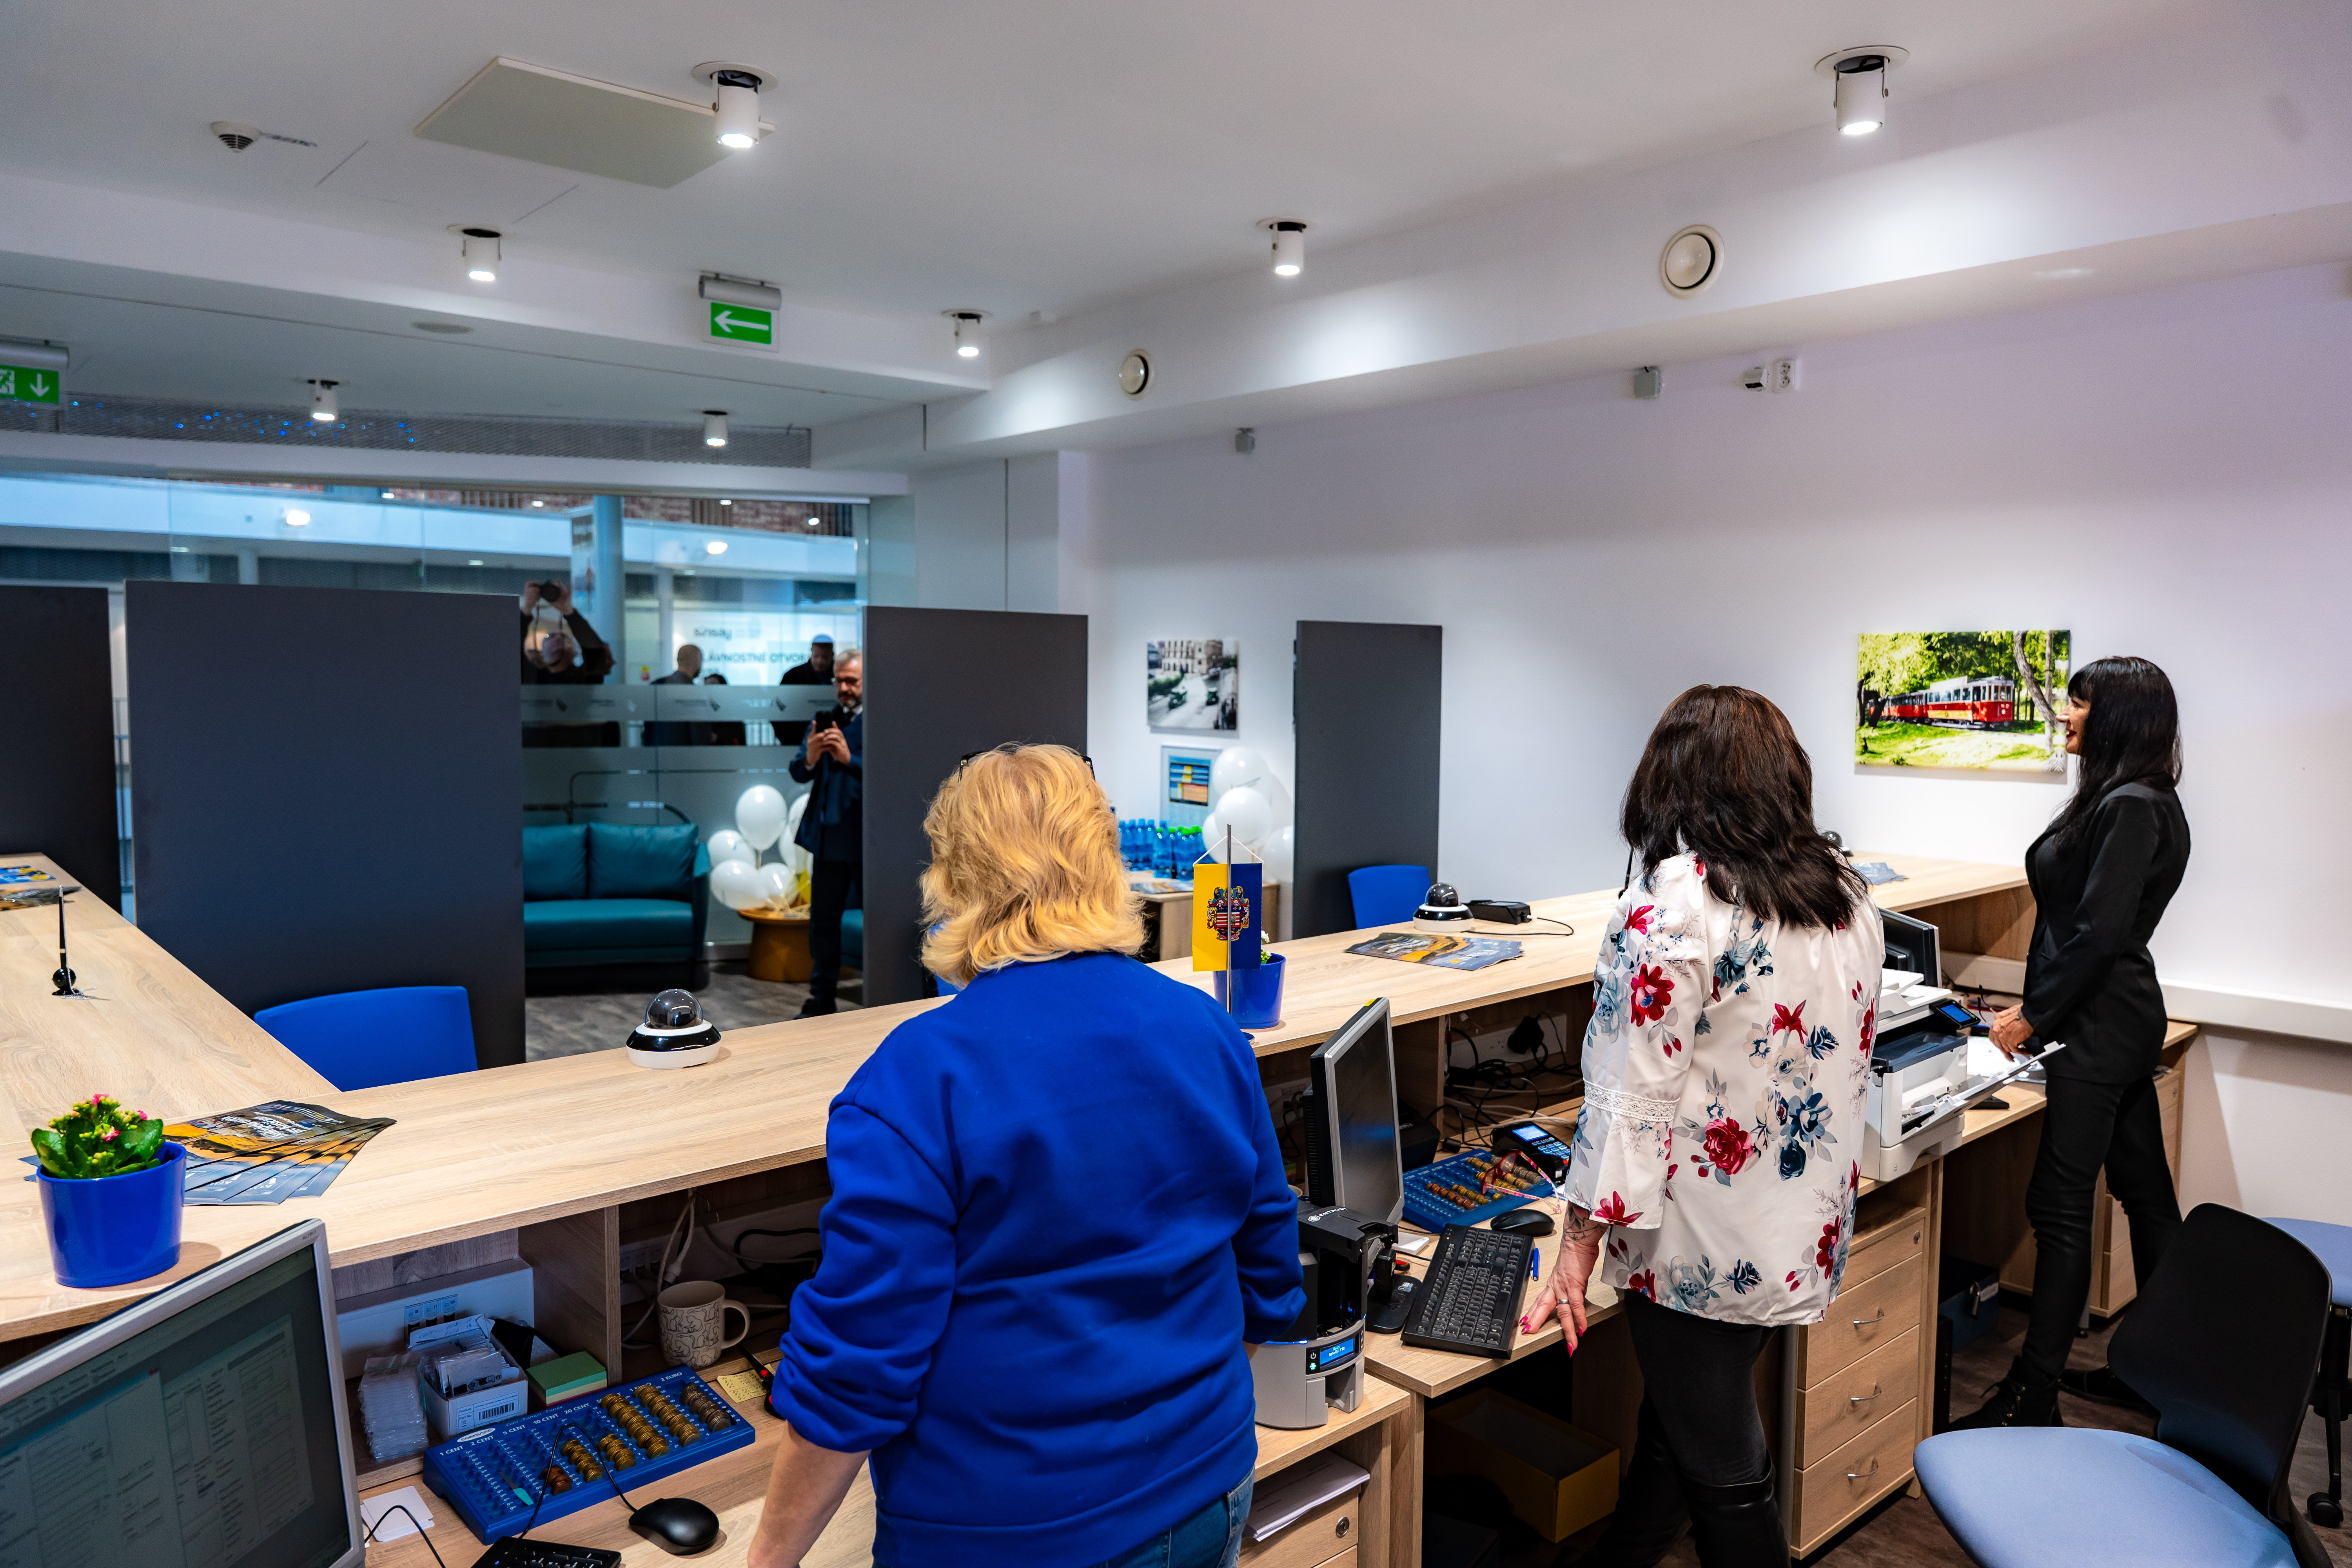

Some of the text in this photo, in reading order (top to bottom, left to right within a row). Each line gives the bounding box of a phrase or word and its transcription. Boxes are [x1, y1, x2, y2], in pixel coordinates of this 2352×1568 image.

[694, 627, 731, 640] sinsay
[704, 650, 808, 663] ÁVNOSTNÉ OTVOR
[1319, 1208, 1347, 1217] ENTRUST
[542, 1413, 559, 1421] CENT
[508, 1424, 526, 1432] CENT
[461, 1428, 492, 1441] COMSAFE
[476, 1435, 494, 1443] CENT
[446, 1445, 463, 1454] CENT
